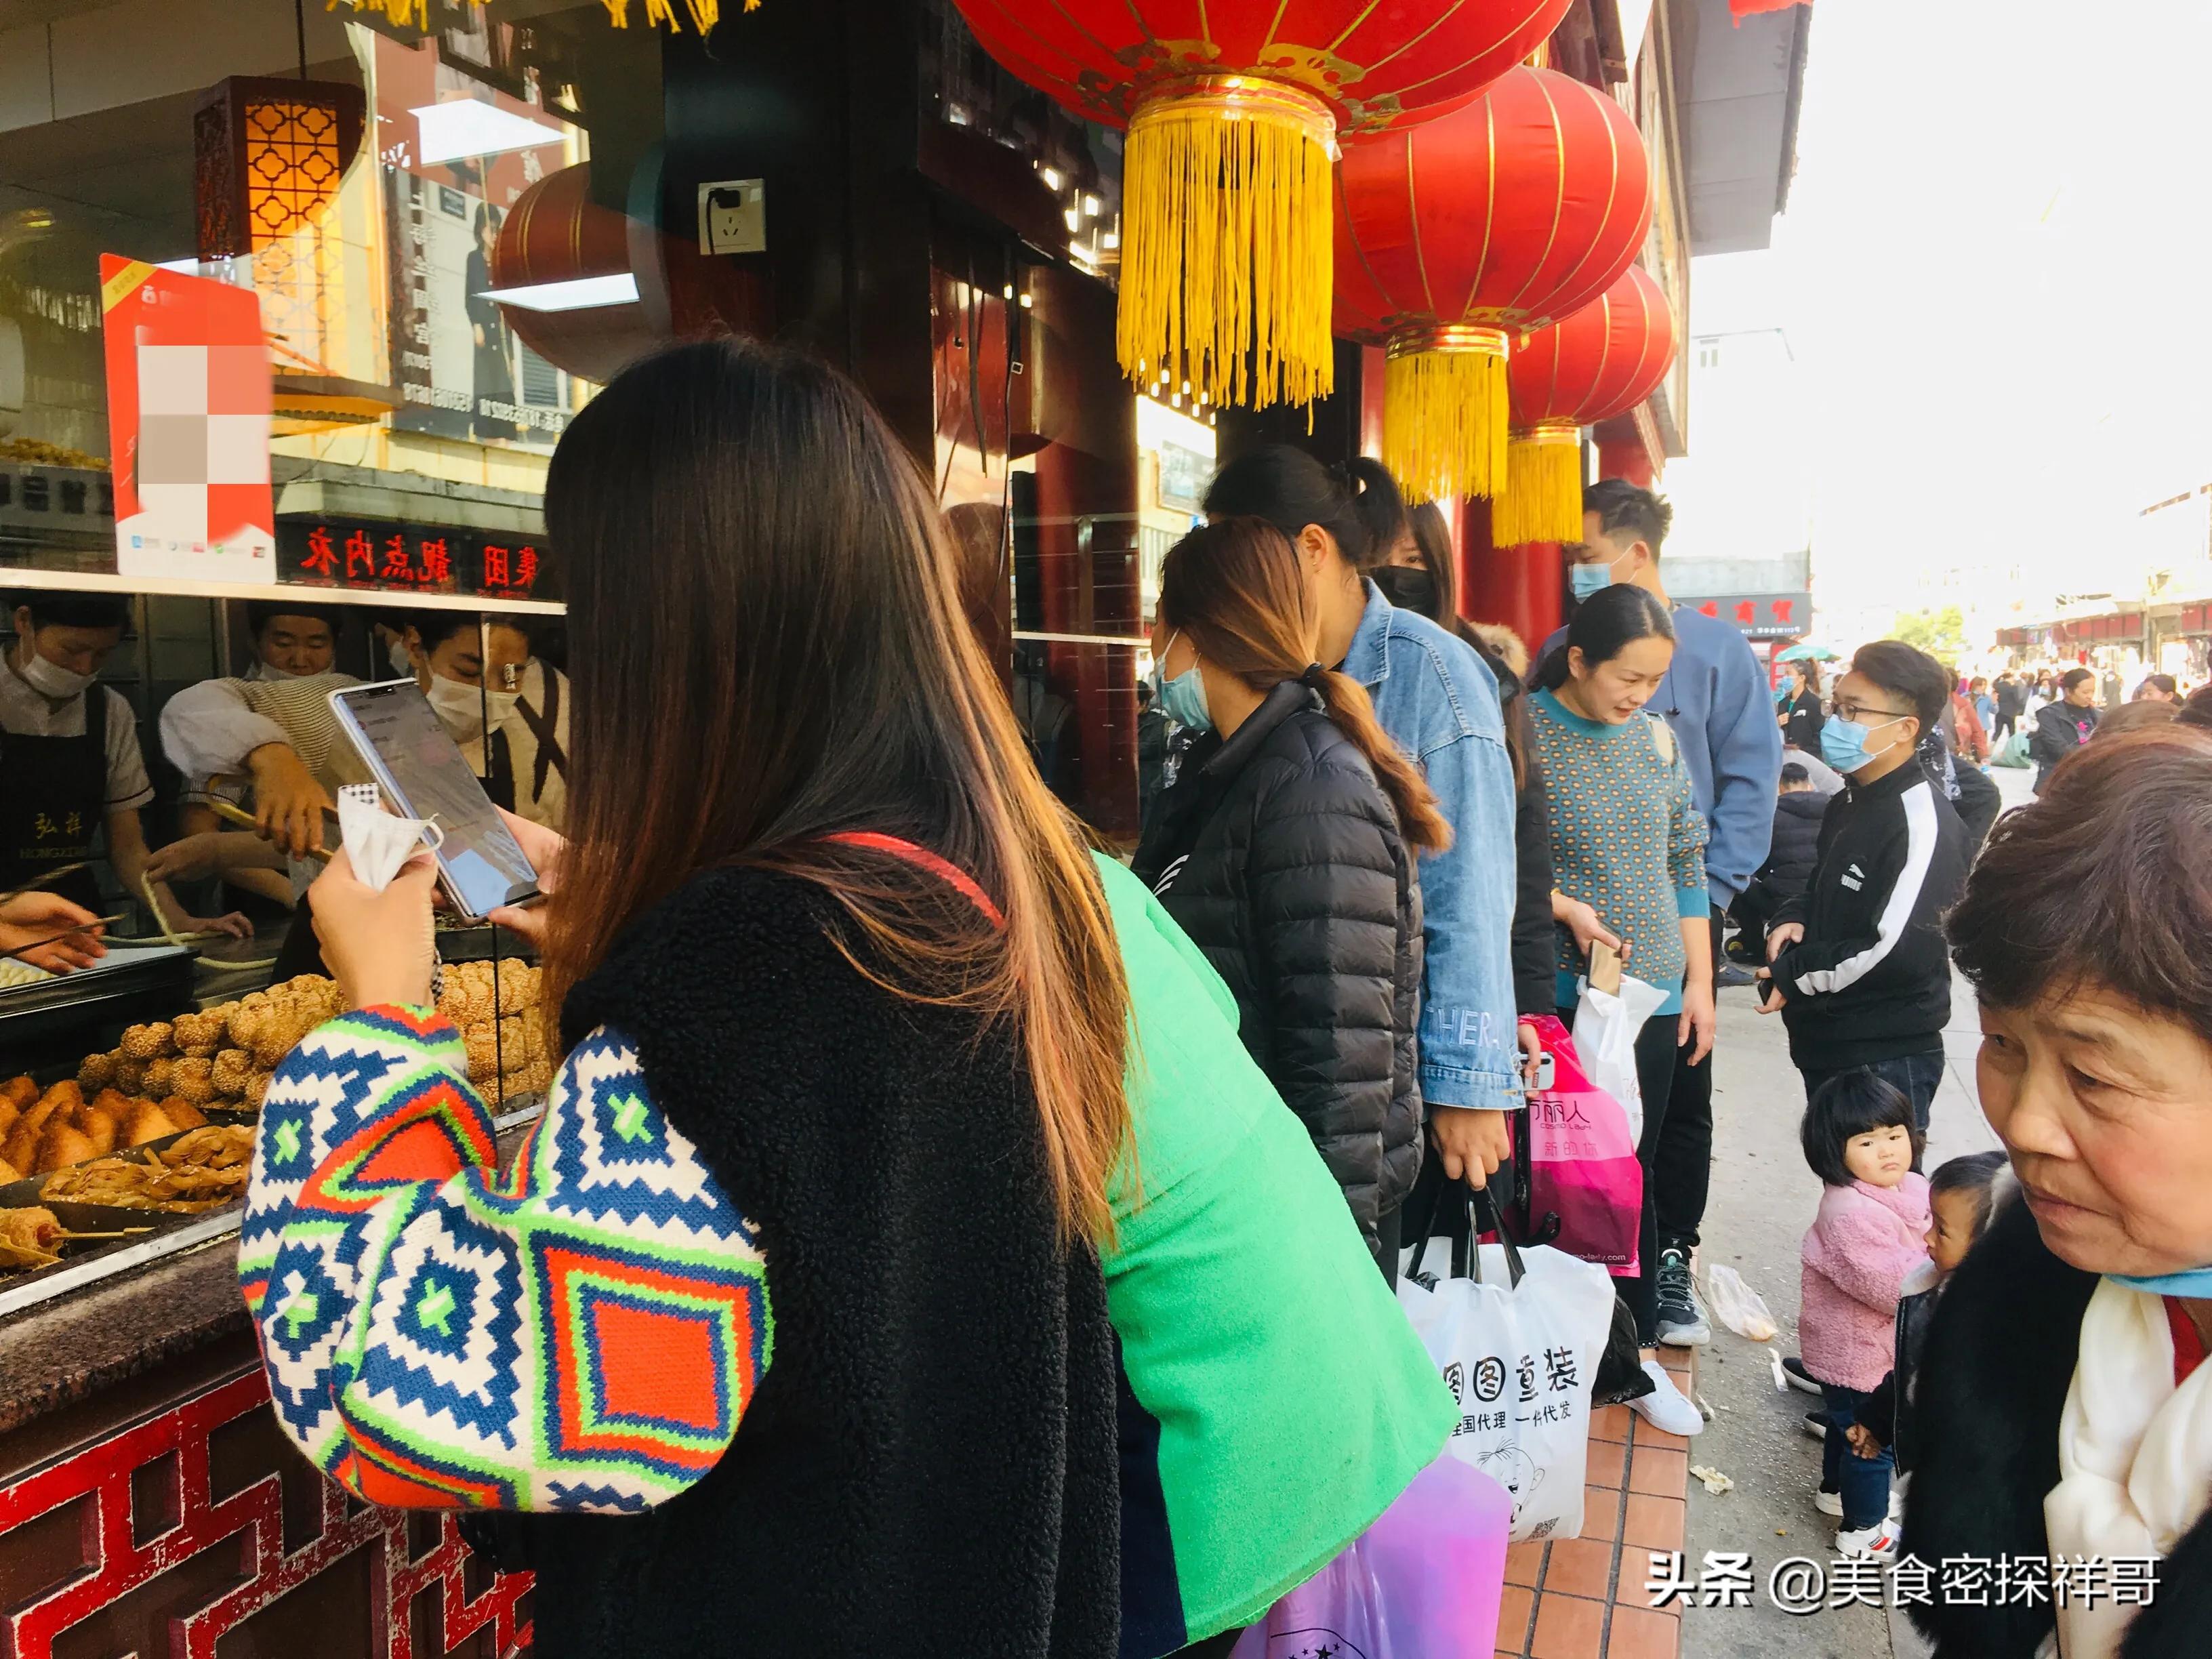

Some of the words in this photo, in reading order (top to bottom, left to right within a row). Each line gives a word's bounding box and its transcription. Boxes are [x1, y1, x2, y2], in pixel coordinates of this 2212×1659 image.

[1544, 1141, 1599, 1157] 新的你
[1443, 1346, 1579, 1406] 图图童装
[1515, 1400, 1572, 1427] 一件代发
